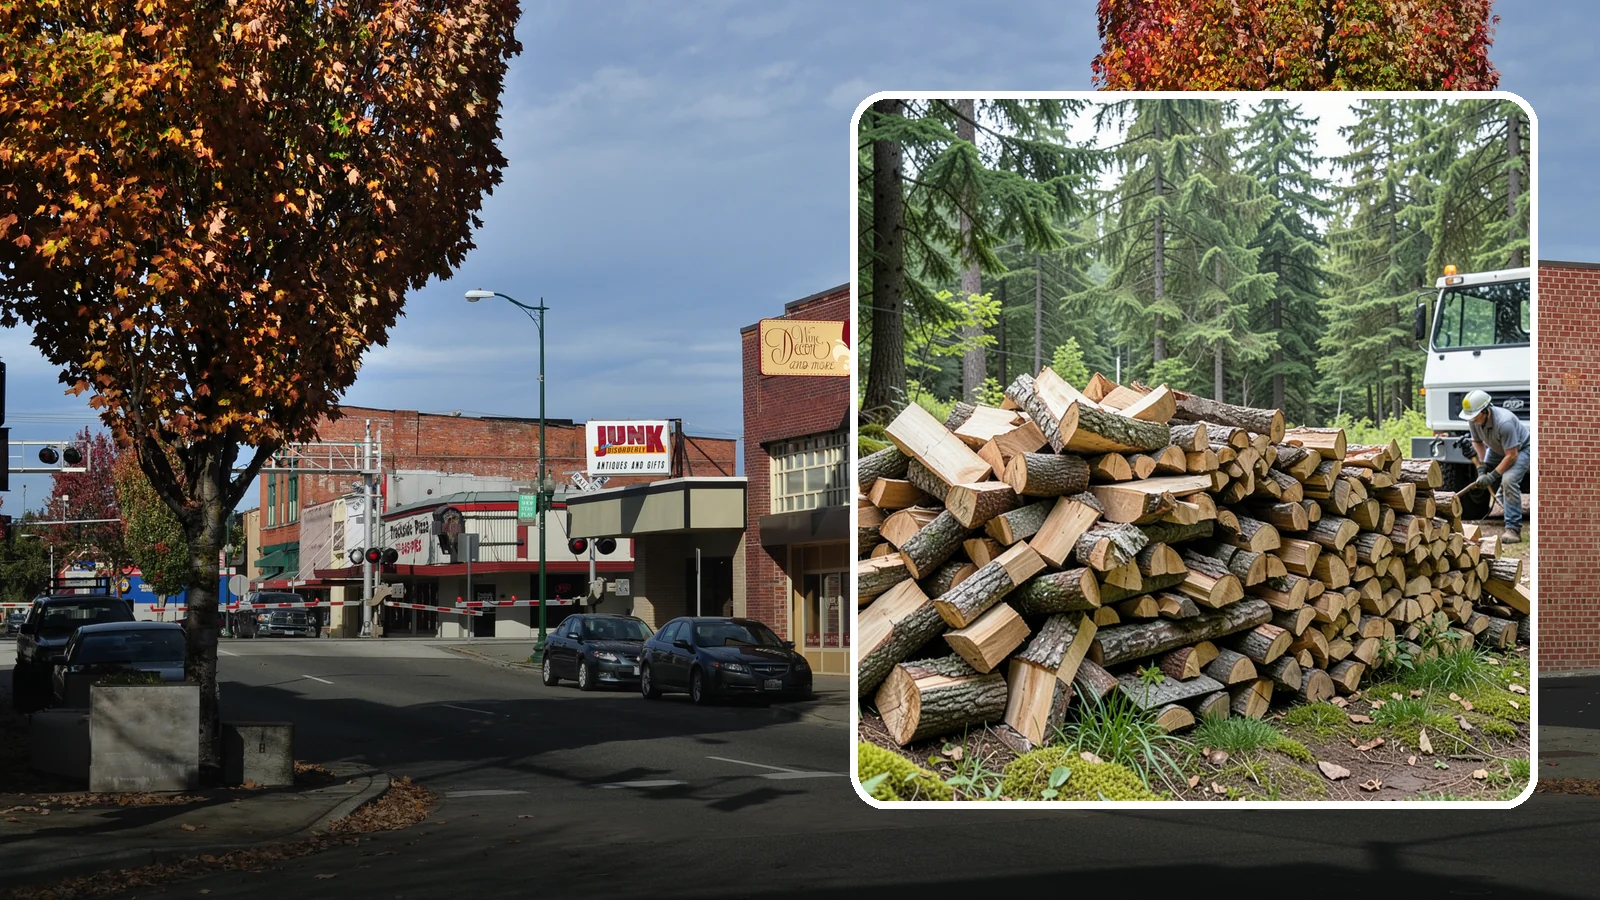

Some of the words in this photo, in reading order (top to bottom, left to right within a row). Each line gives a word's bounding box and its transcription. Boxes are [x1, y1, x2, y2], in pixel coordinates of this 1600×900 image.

[595, 425, 665, 457] JUNK
[607, 446, 646, 454] DISORDERLY
[597, 461, 628, 470] ANTIQUES
[631, 461, 644, 470] AND
[647, 460, 665, 470] GIFTS
[415, 519, 429, 535] Pizza
